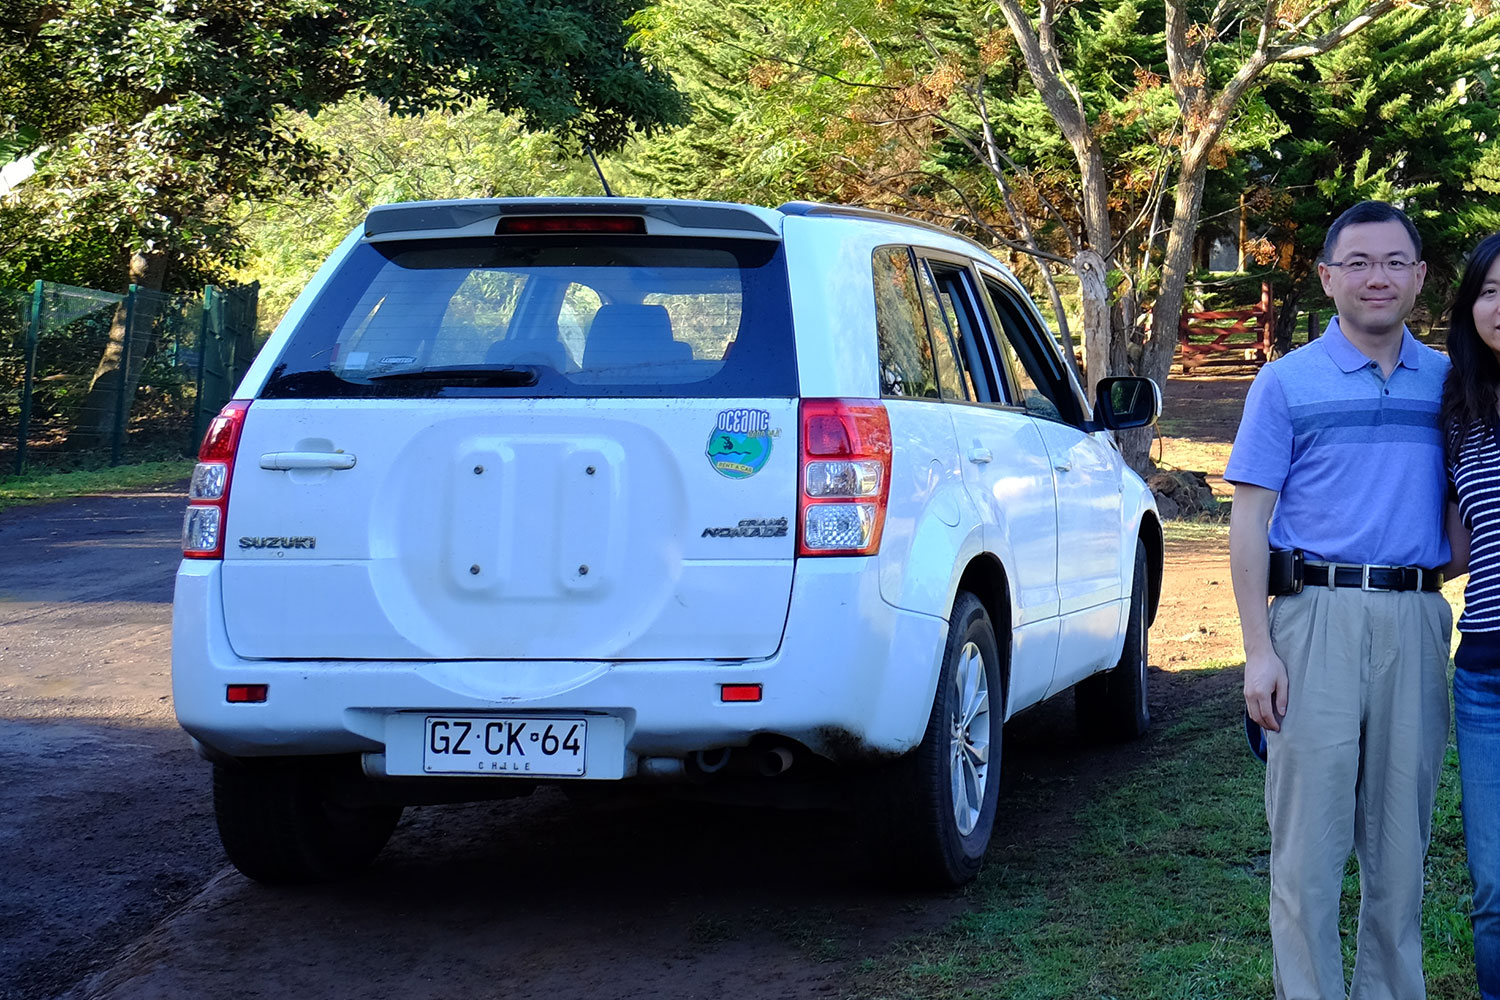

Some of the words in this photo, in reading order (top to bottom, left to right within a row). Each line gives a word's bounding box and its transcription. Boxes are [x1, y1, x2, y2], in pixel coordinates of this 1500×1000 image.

[701, 527, 788, 538] NOMADE
[239, 536, 316, 549] SUZUKI
[478, 761, 531, 771] CHILE
